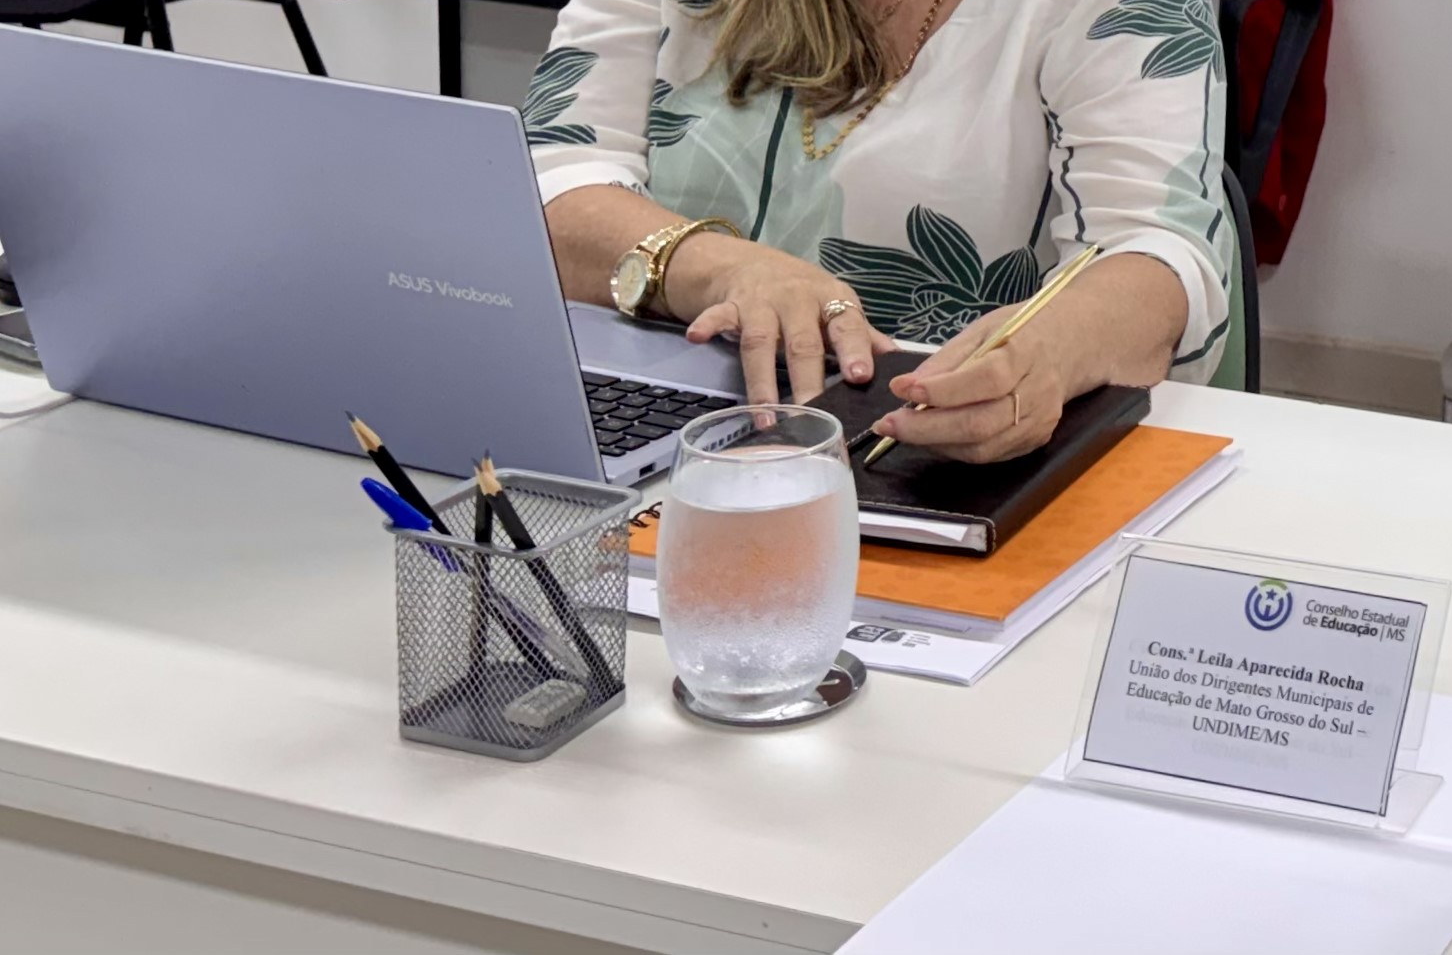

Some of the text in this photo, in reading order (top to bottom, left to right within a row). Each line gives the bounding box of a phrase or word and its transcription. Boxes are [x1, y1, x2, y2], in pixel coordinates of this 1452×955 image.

[388, 271, 514, 308] ASUS Vivobook
[1302, 613, 1319, 627] de
[1320, 616, 1378, 637] Educação
[1386, 627, 1406, 642] MS
[1306, 599, 1410, 628] Conselho Estadual
[1128, 659, 1170, 680] União
[1173, 667, 1198, 685] dos
[1200, 671, 1272, 698] Dirigentes
[1276, 684, 1354, 712] Municipais
[1356, 699, 1375, 716] de
[1196, 649, 1234, 668] Leila
[1236, 657, 1313, 683] Aparecida
[1317, 669, 1364, 692] Rocha
[1126, 681, 1192, 706] Educação
[1195, 694, 1213, 710] de
[1214, 697, 1252, 717] Mato
[1256, 704, 1305, 726] Grosso
[1307, 714, 1327, 731] do
[1329, 716, 1355, 735] Sul
[1192, 715, 1290, 747] UNDIME/MS
